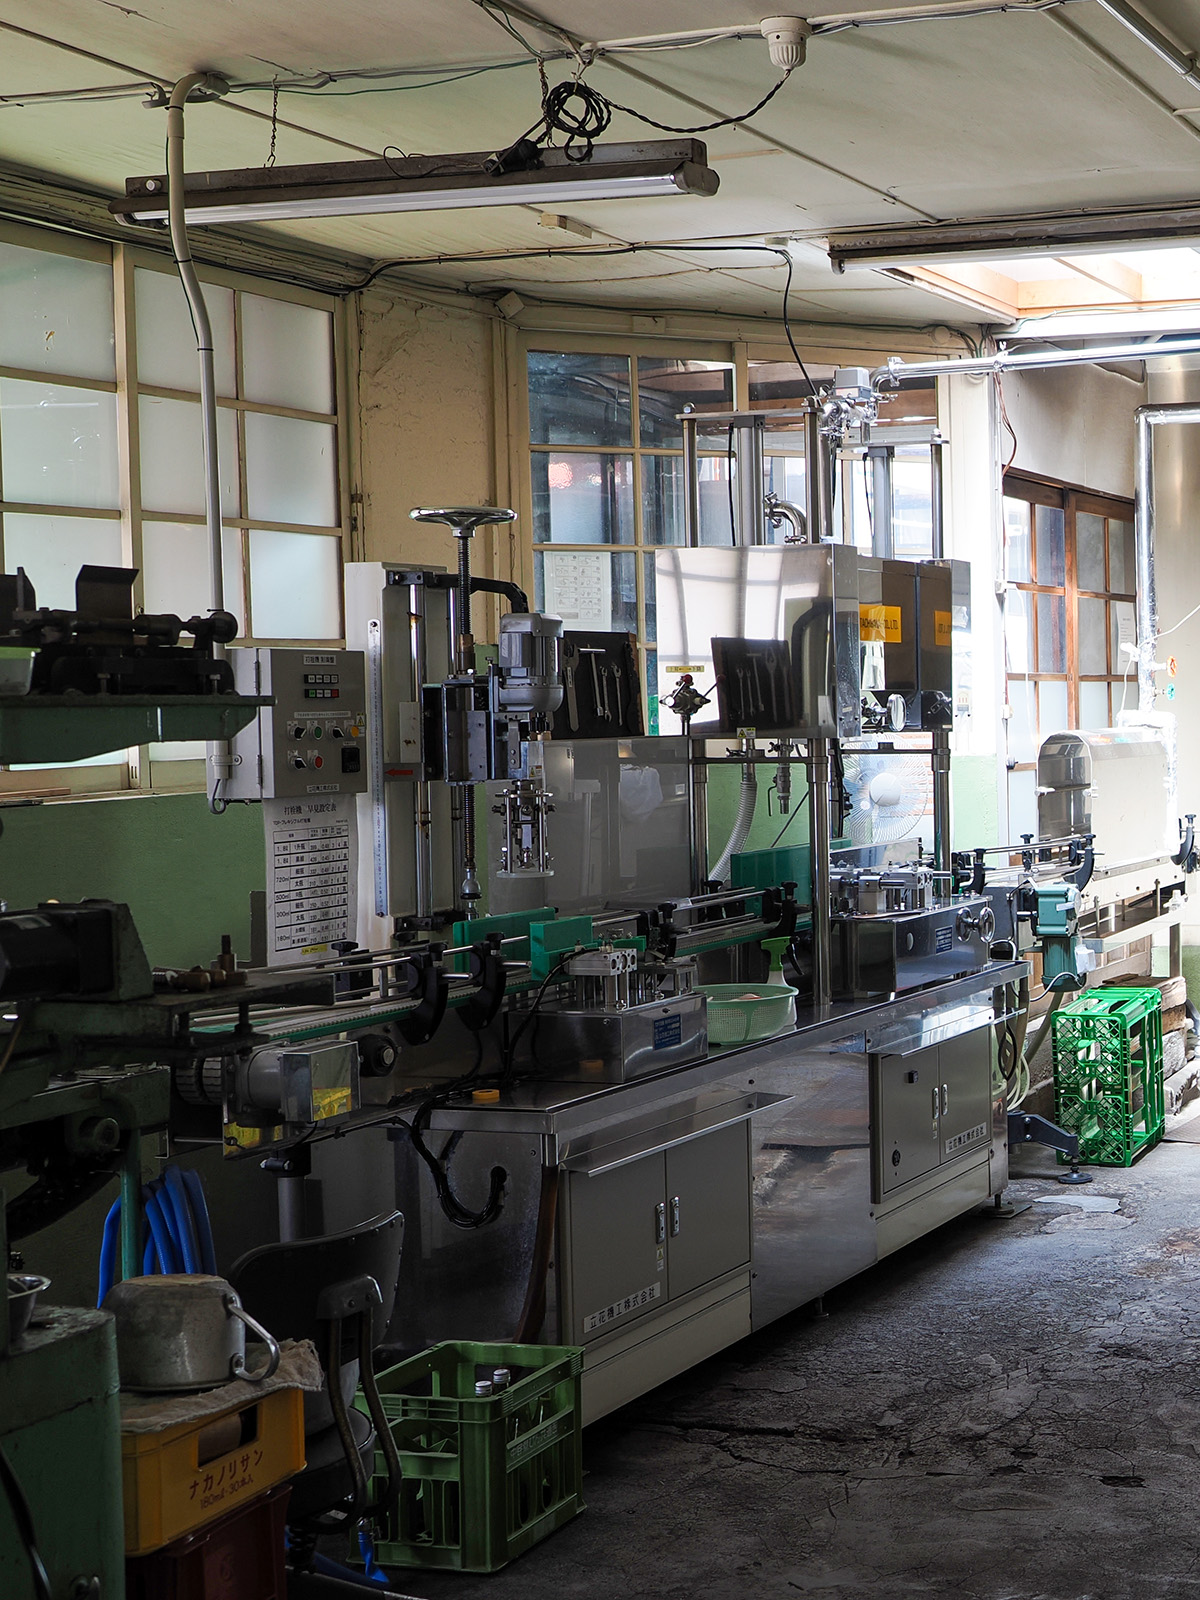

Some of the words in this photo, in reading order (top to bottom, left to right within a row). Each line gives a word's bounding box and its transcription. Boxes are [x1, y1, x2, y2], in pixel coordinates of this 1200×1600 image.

[590, 1287, 655, 1329] 立花機工株式会社
[189, 1449, 263, 1500] ナカノリサン
